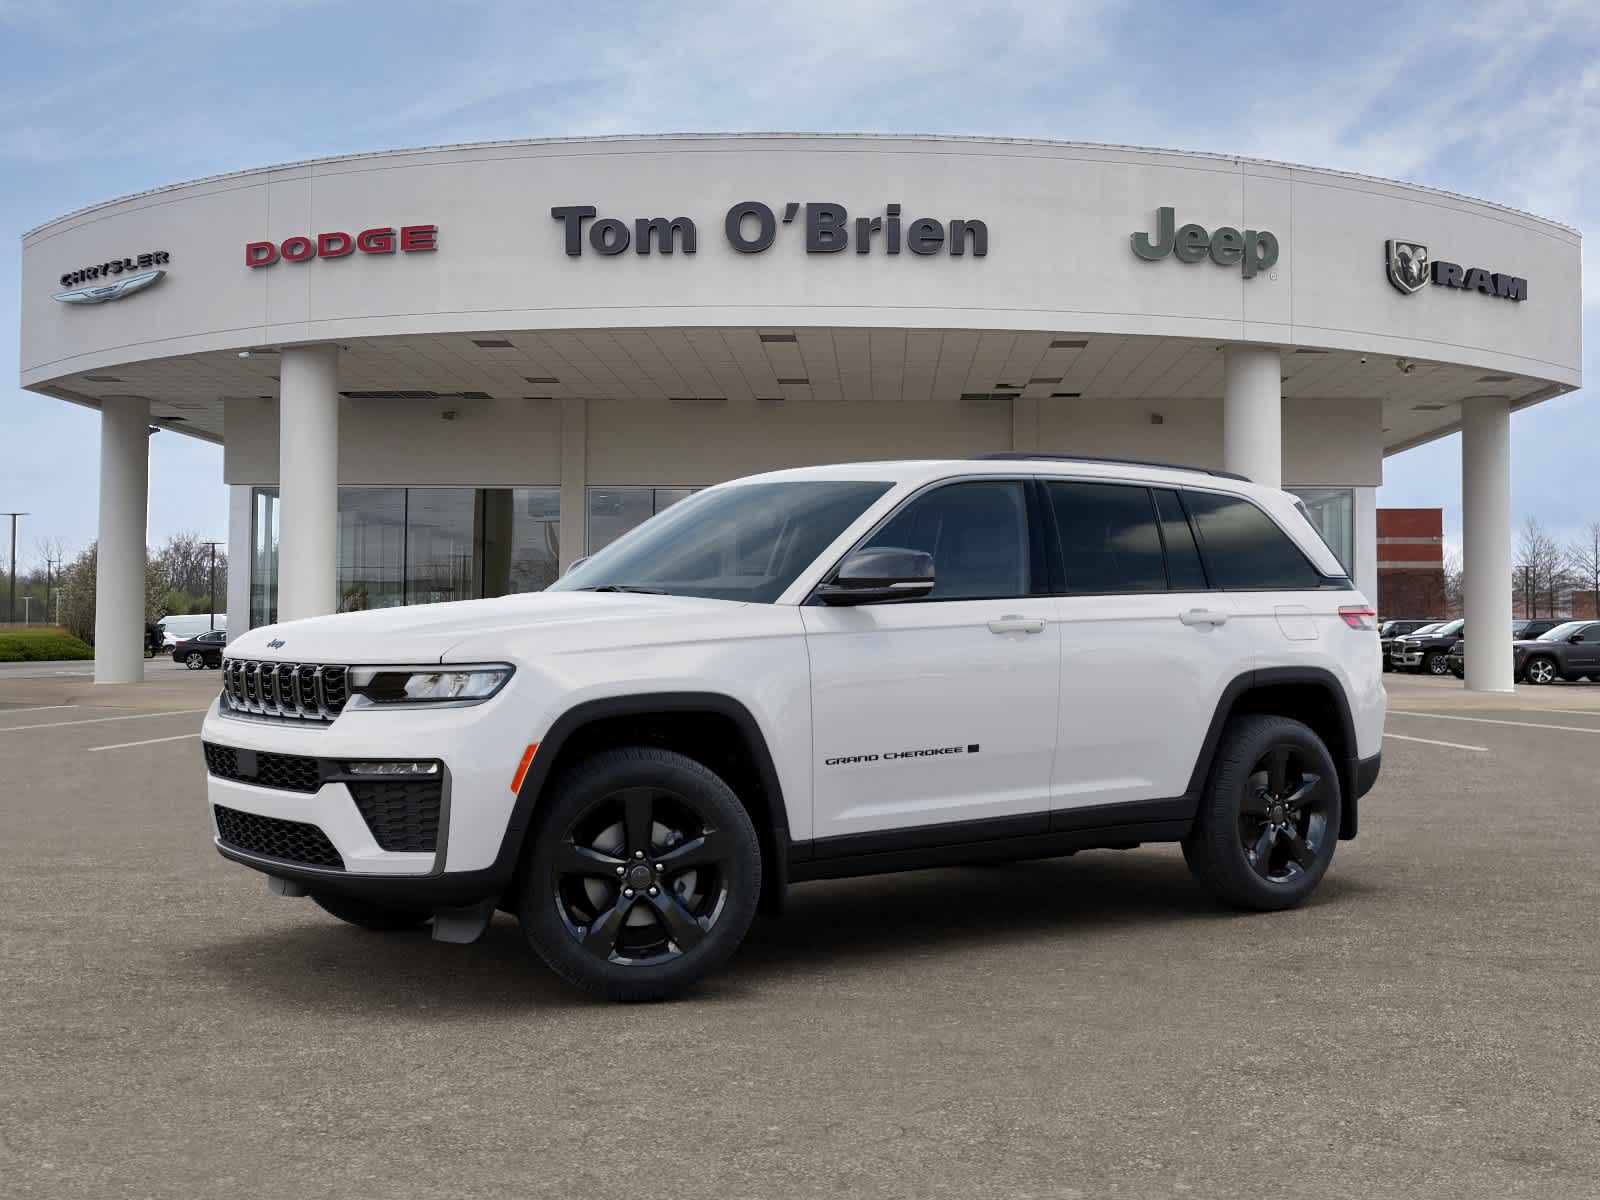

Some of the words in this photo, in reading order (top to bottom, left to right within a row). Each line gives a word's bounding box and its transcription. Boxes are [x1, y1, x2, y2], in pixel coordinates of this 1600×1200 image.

[246, 224, 438, 269] DODGE
[551, 205, 697, 256] Tom
[725, 201, 988, 256] O'Brien
[1130, 207, 1280, 279] Jeep
[60, 250, 170, 287] CHRYSLER
[1430, 260, 1528, 301] RAM
[825, 754, 879, 766] GRAND
[883, 746, 964, 760] CHEROKEE
